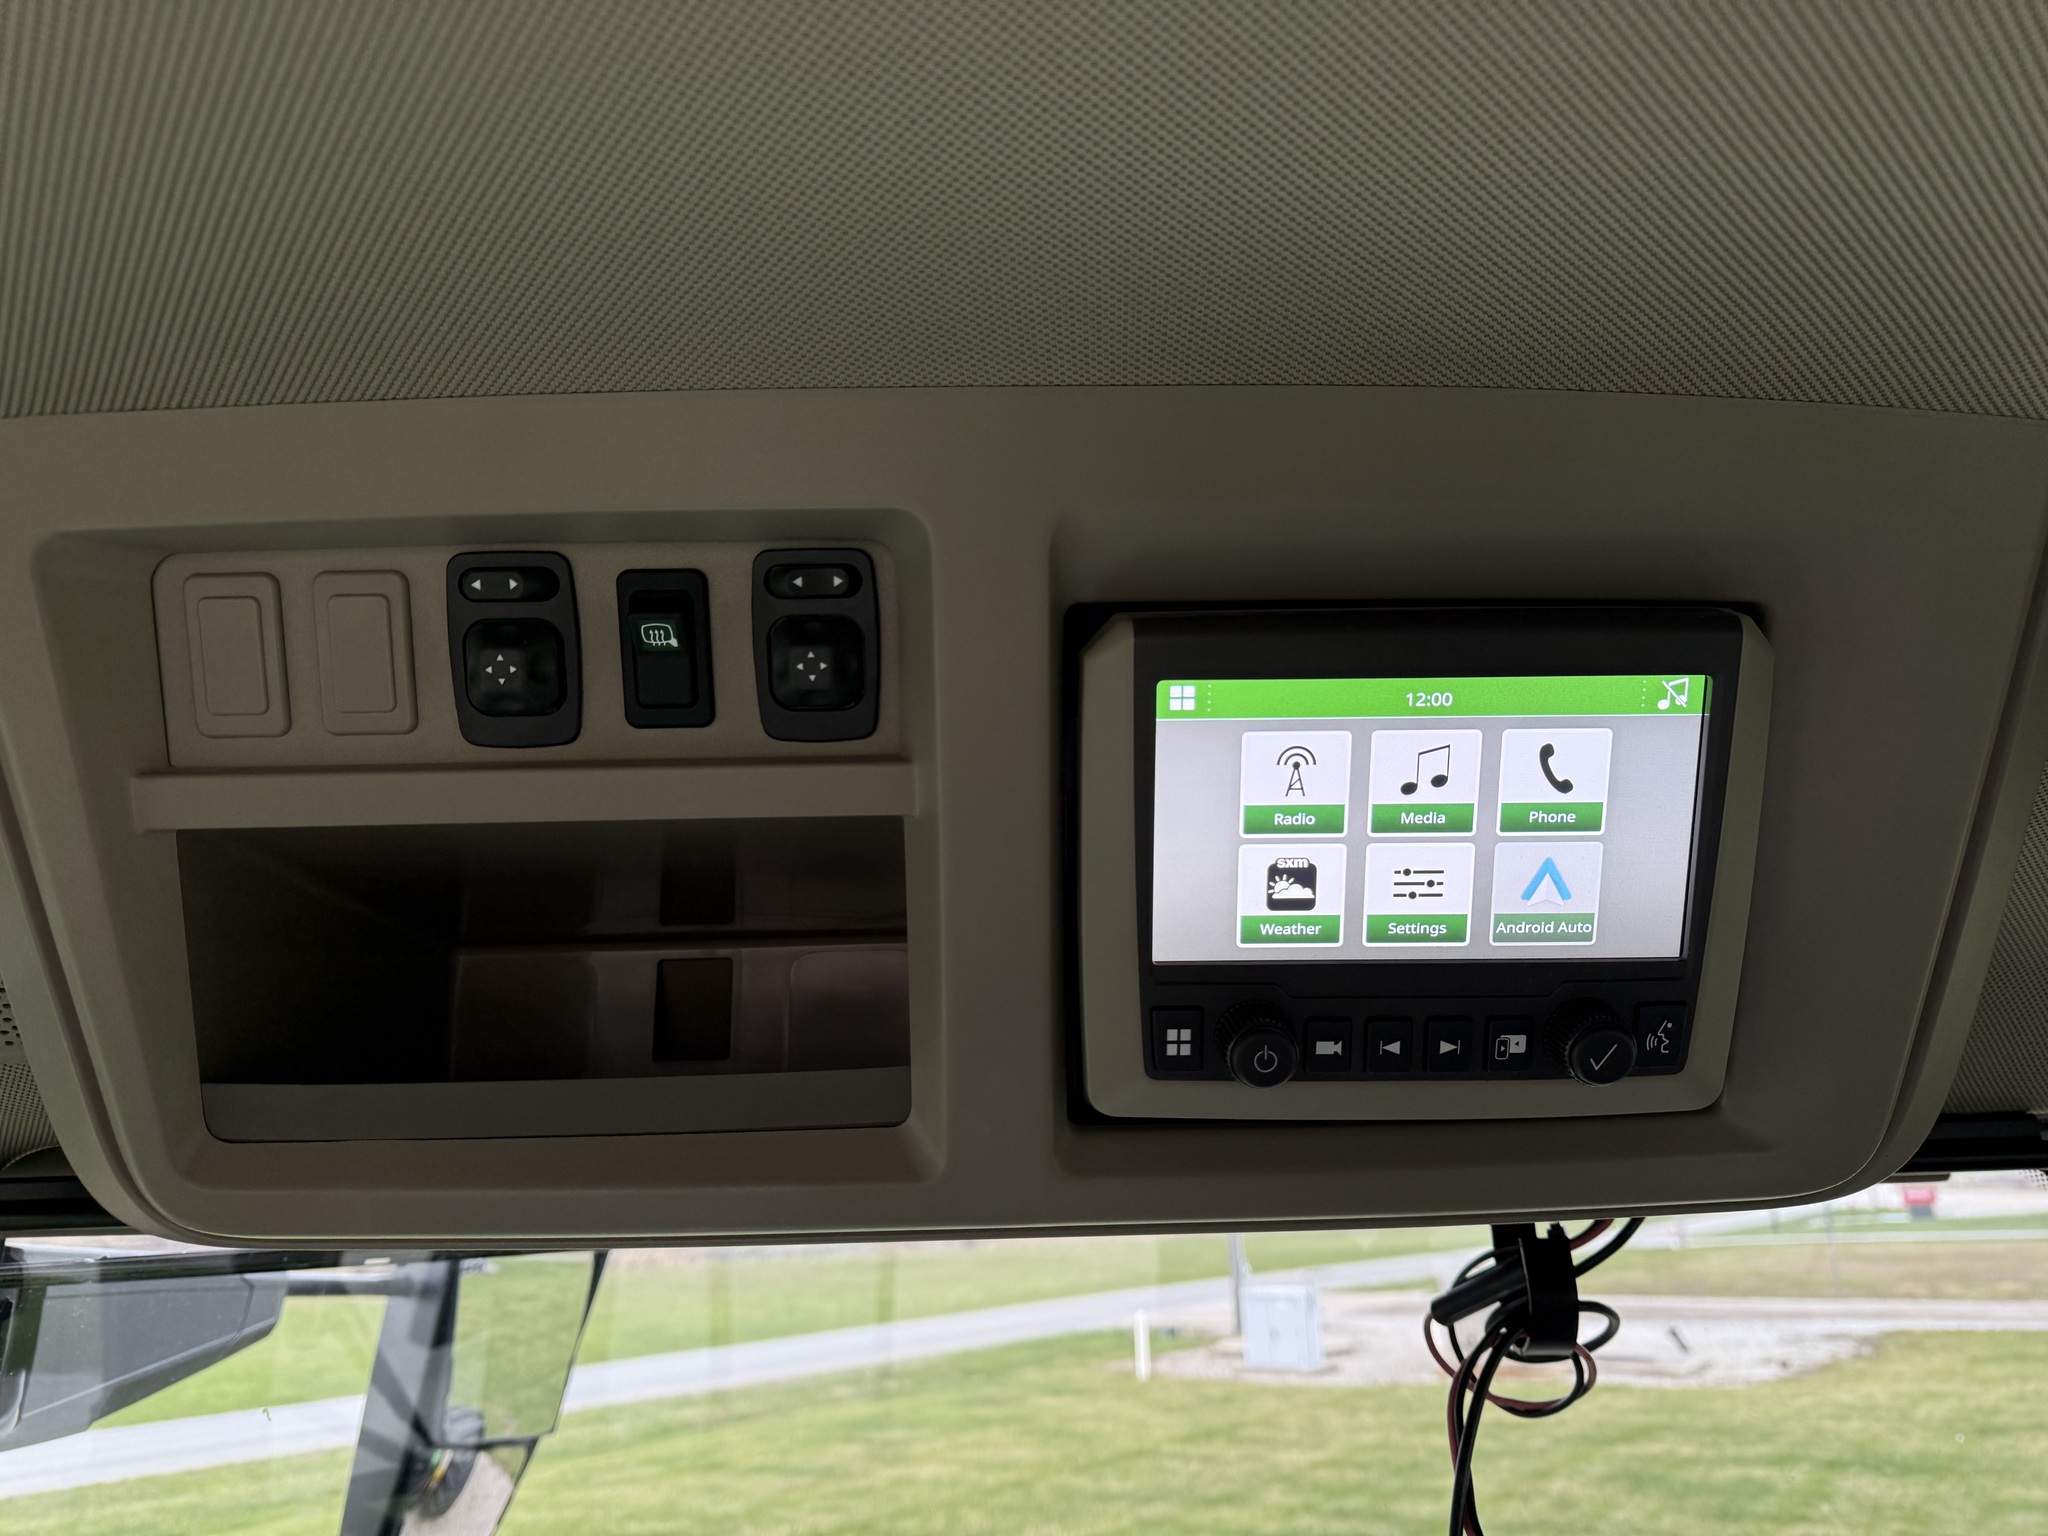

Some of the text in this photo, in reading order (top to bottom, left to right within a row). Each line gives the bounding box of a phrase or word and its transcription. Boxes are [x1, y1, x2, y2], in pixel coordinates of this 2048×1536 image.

[1406, 692, 1453, 706] 12:00
[1273, 813, 1315, 826] Radio
[1400, 812, 1446, 825] Media
[1528, 810, 1576, 824] Phone
[1276, 857, 1309, 869] sxm
[1259, 923, 1322, 936] Weather
[1387, 922, 1447, 937] Settings
[1496, 921, 1592, 935] Android Auto
